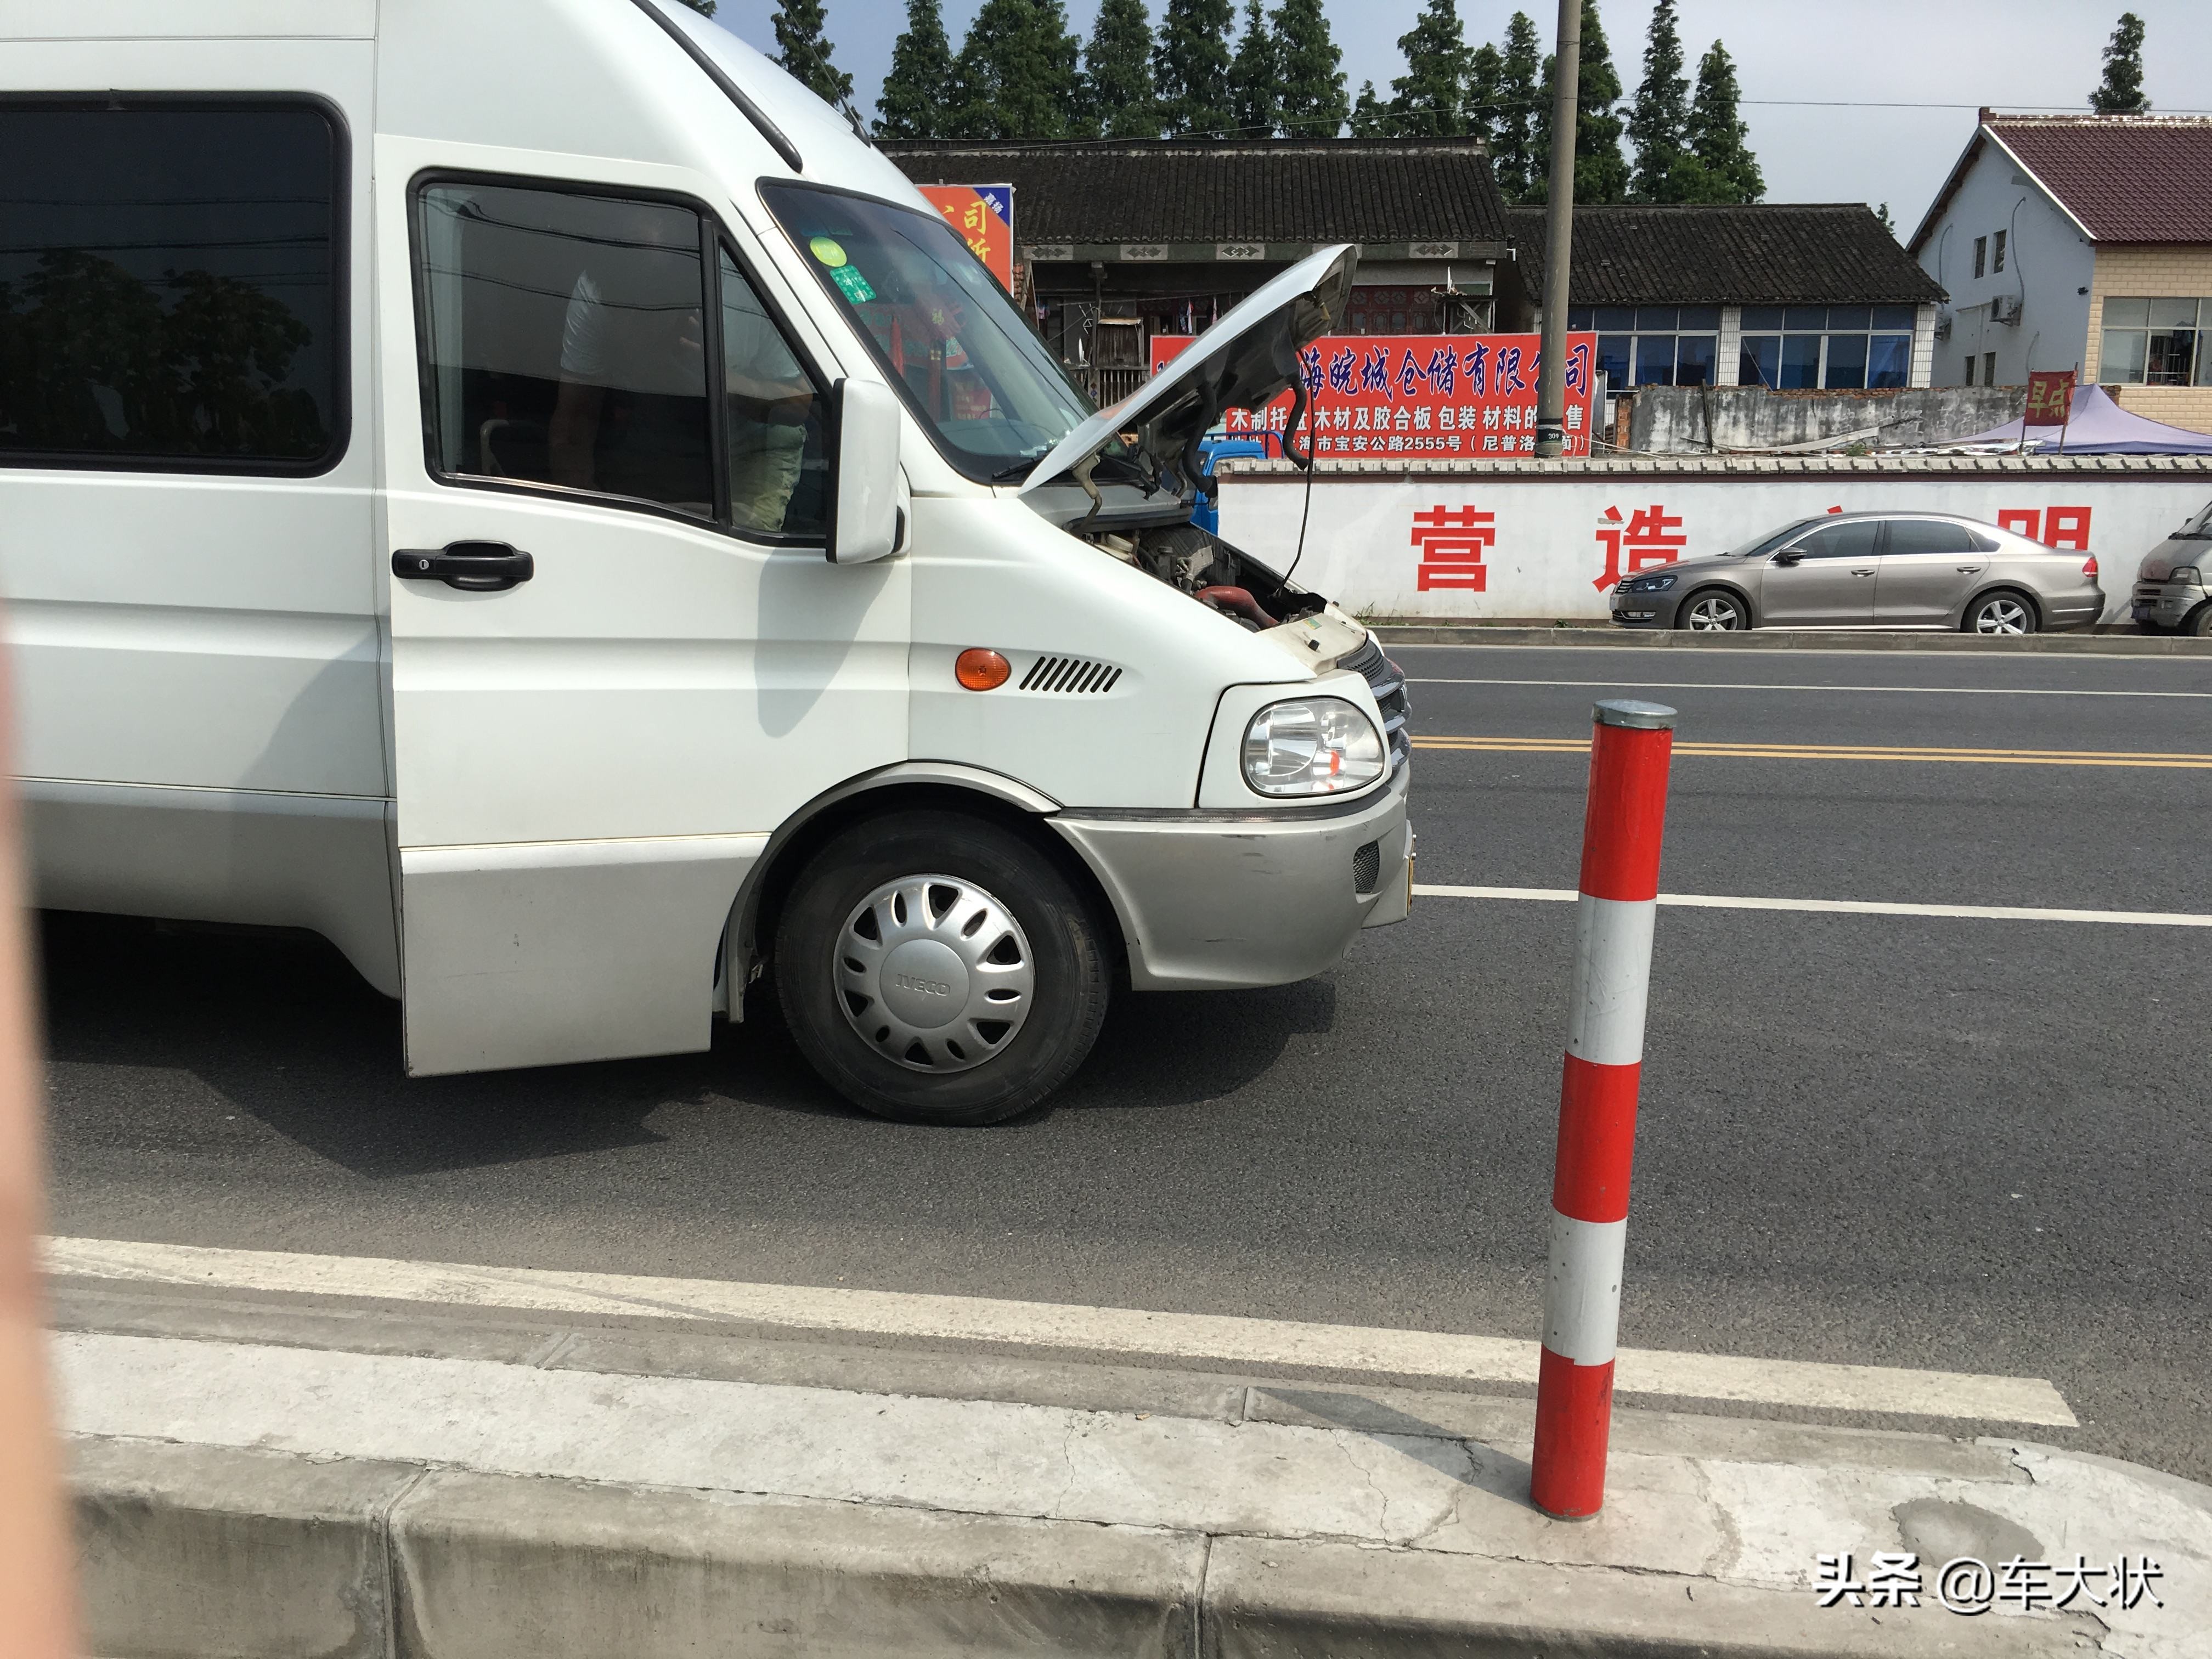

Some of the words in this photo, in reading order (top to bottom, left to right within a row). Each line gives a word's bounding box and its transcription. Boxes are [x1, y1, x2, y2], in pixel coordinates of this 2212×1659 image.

[1299, 341, 1589, 403] 海皖城仓储有限司
[2028, 379, 2070, 419] 早点
[895, 973, 951, 996] IVECO
